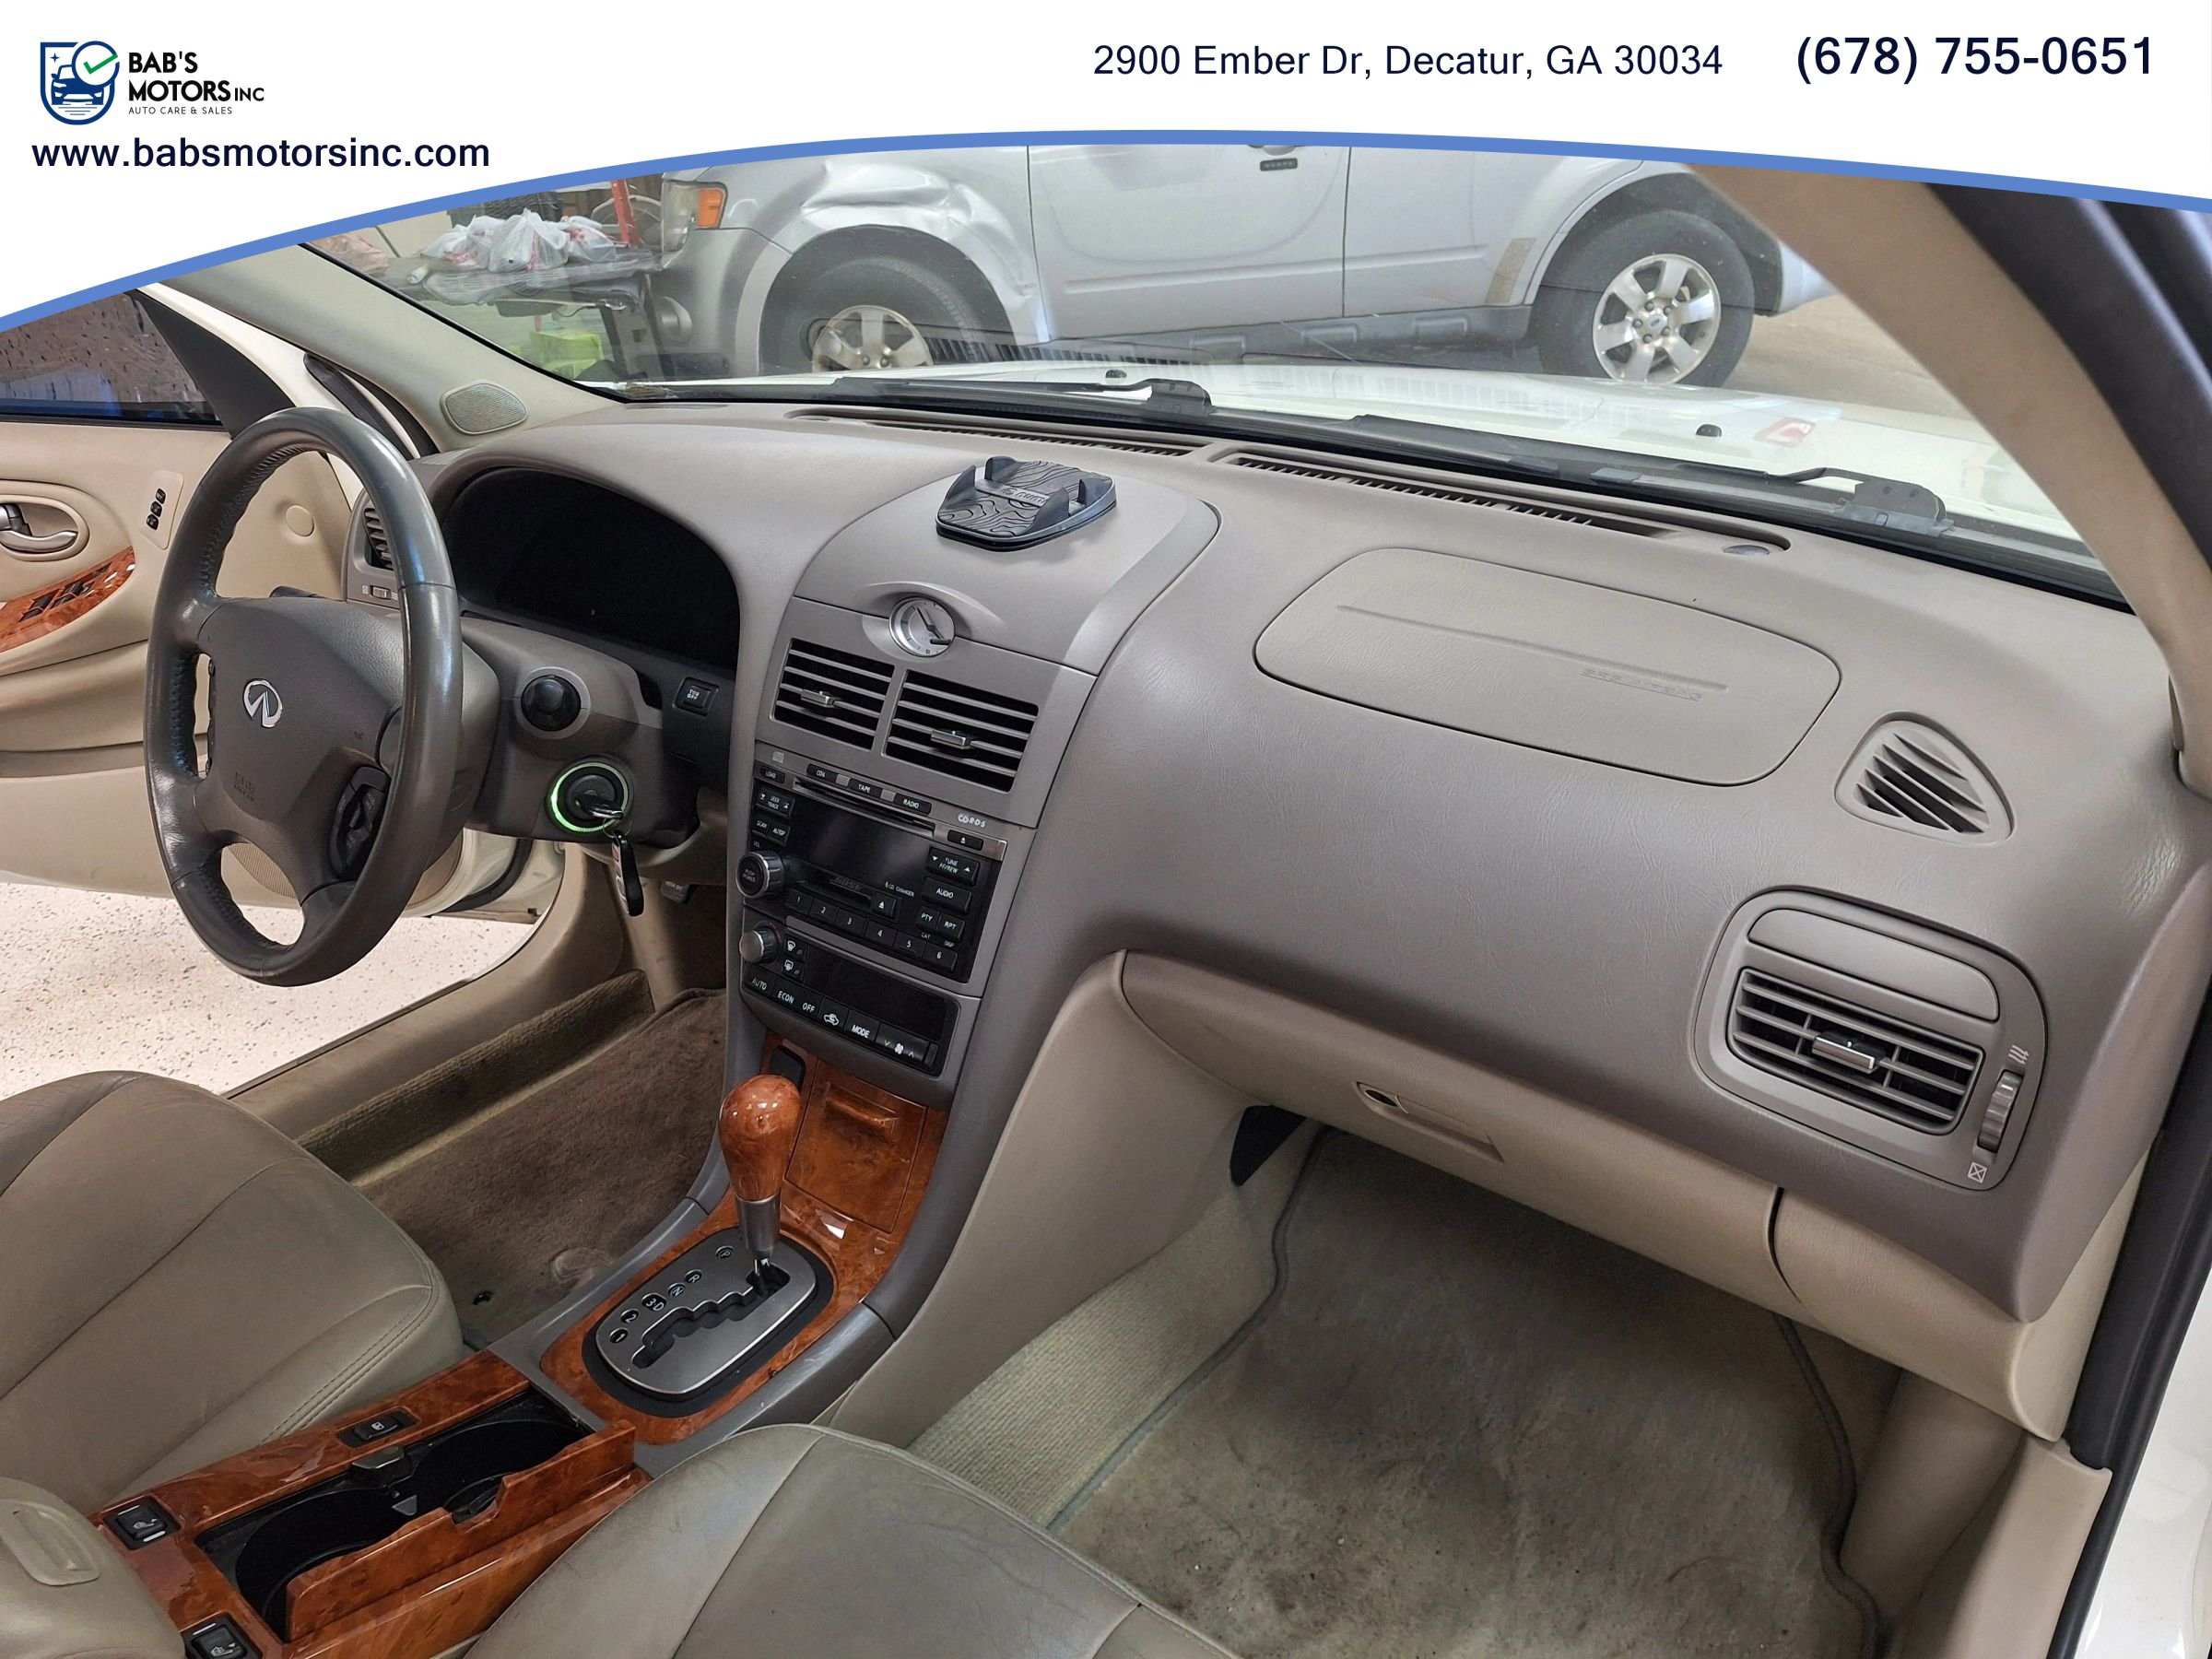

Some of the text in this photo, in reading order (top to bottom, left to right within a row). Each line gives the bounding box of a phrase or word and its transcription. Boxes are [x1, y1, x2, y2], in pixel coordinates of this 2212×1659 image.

[858, 783, 871, 793] TAPE
[903, 798, 920, 809] RADIO
[935, 888, 954, 899] AUDIO
[820, 906, 827, 914] 2
[847, 917, 853, 925] 3
[921, 912, 934, 922] PTY
[944, 921, 957, 930] RPT
[877, 929, 883, 937] 4
[906, 940, 912, 948] 5
[936, 951, 942, 959] 6
[751, 977, 767, 991] AUTO
[777, 991, 794, 1005] ECON
[802, 1002, 816, 1013] OFF
[851, 1024, 871, 1039] MODE
[688, 1274, 700, 1283] R
[672, 1286, 683, 1297] N
[625, 1313, 637, 1324] 2
[615, 1333, 626, 1343] 1
